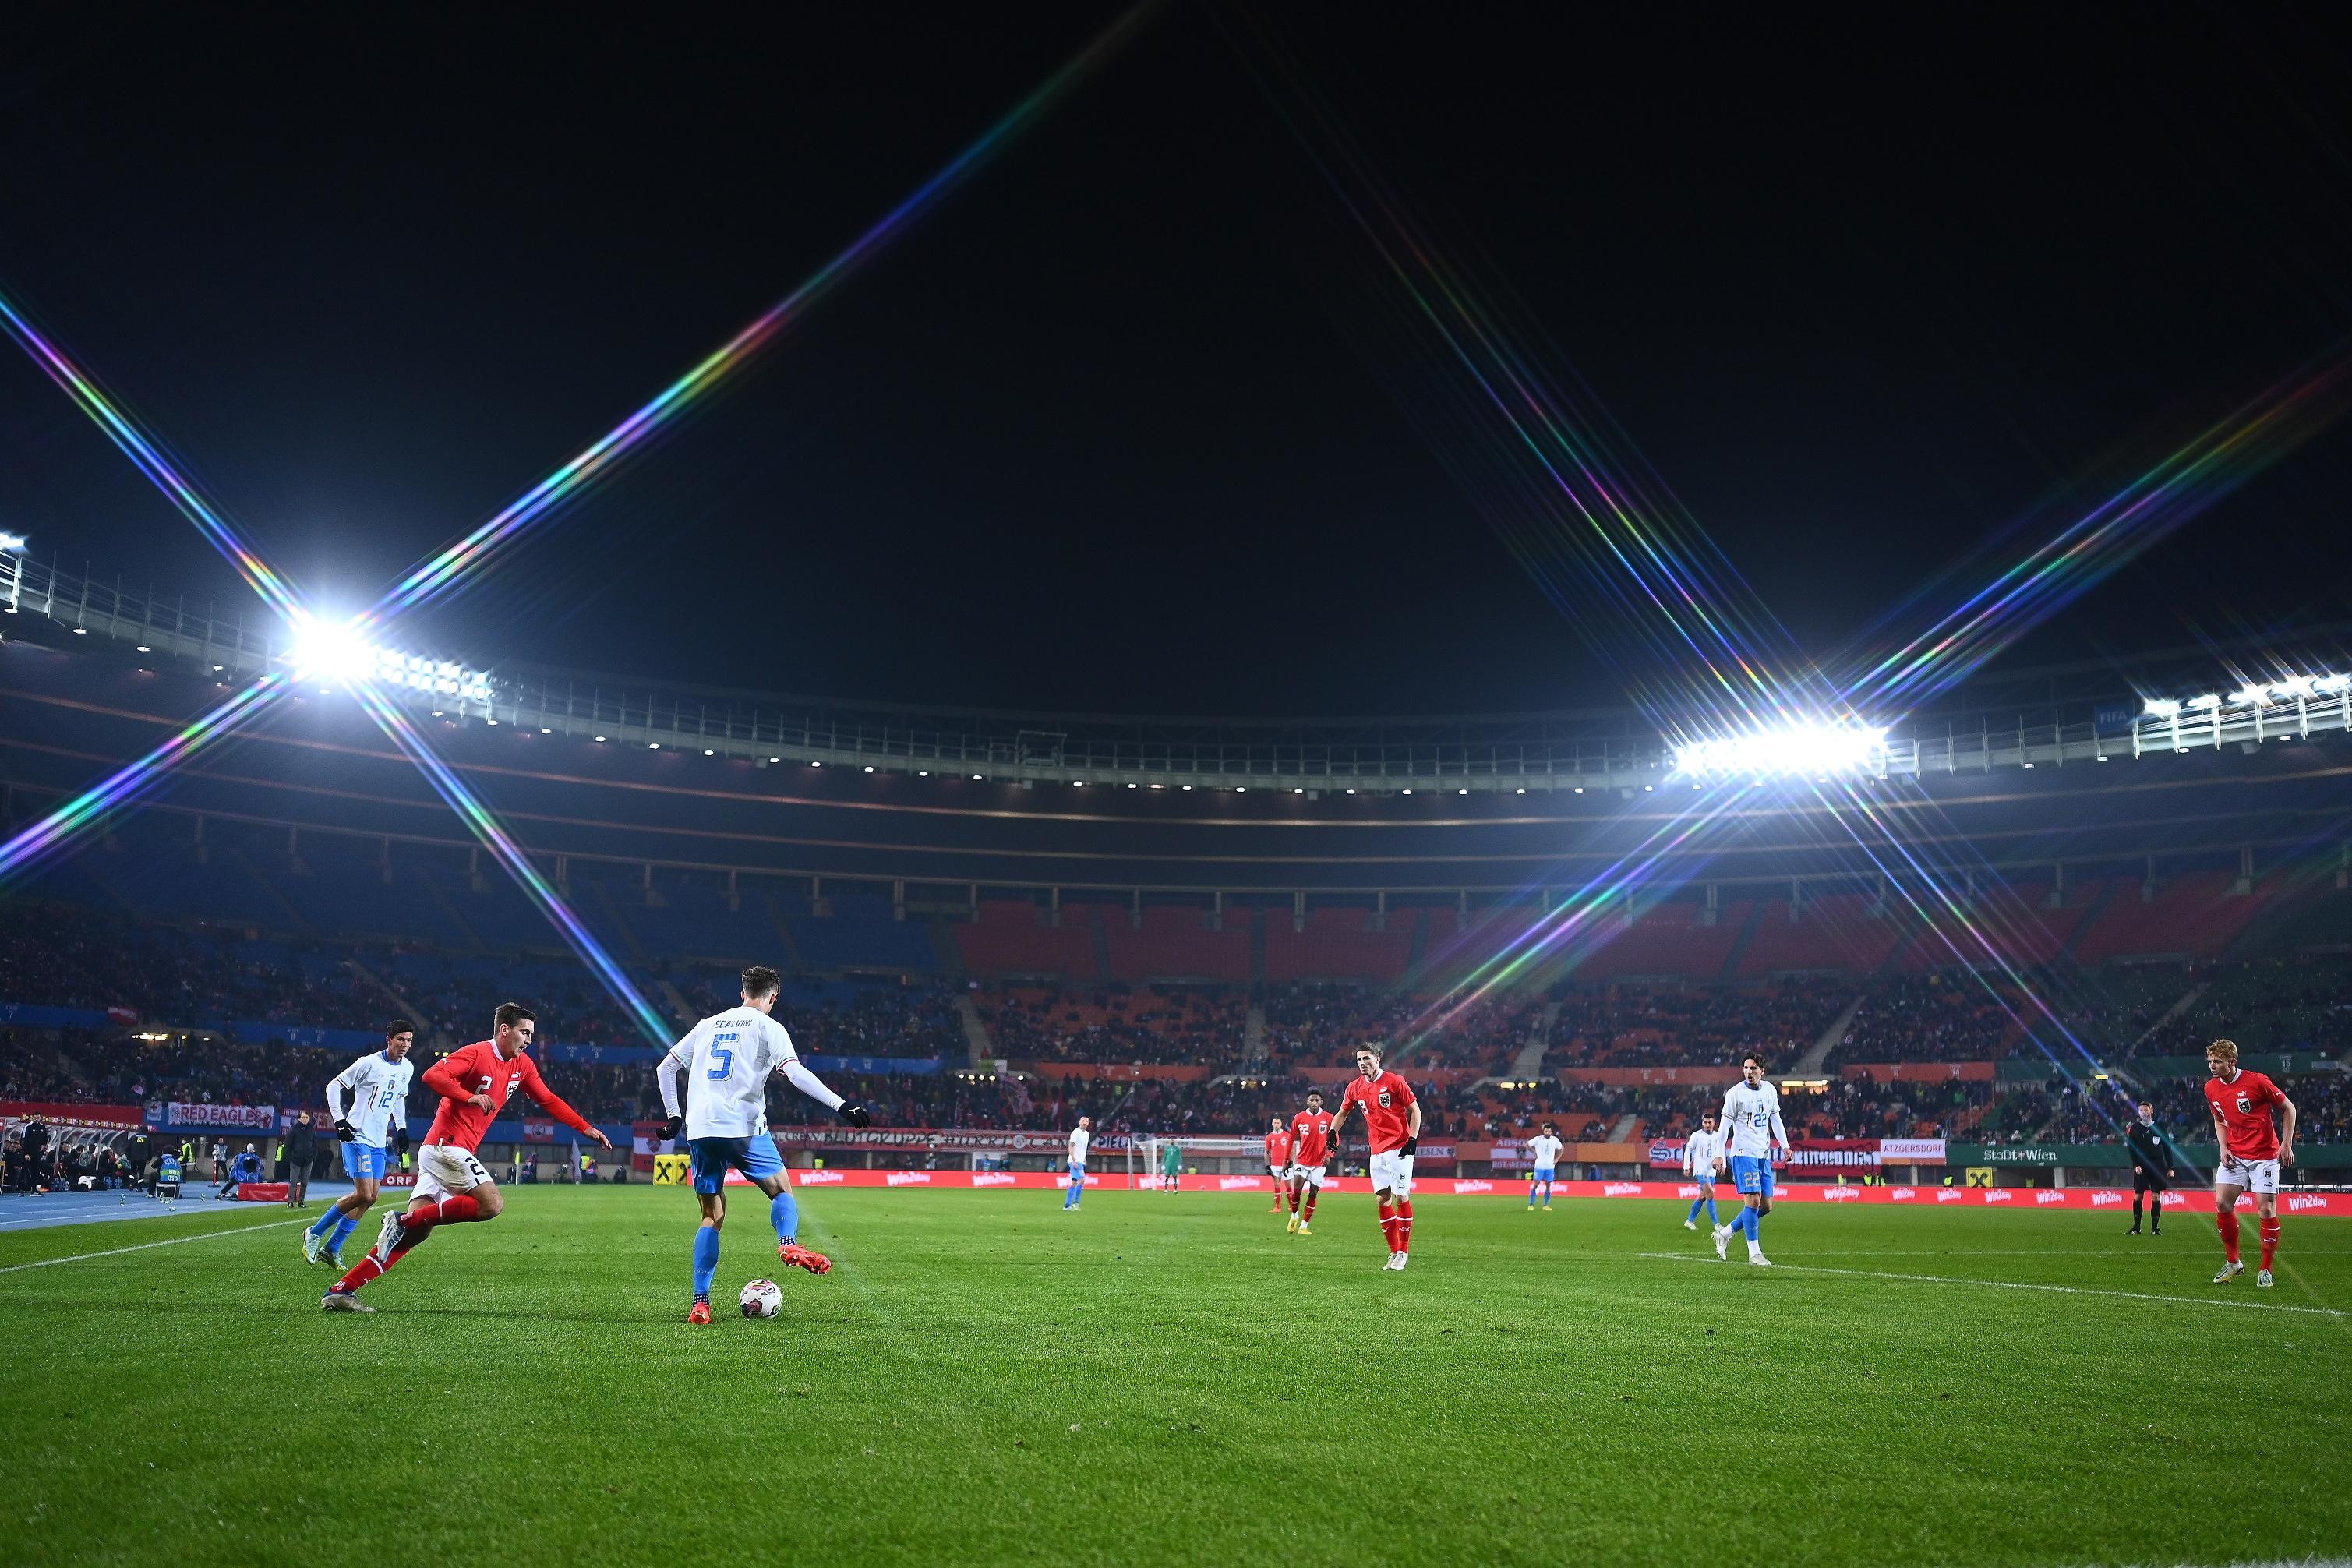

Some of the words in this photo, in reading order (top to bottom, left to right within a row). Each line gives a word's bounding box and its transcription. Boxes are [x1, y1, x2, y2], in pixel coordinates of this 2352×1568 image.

[714, 1019, 753, 1029] SCALVINI
[707, 1033, 740, 1081] 5
[475, 1075, 493, 1095] 2
[378, 1091, 393, 1108] 12
[180, 1107, 207, 1122] RED
[210, 1107, 262, 1124] EAGLES
[1753, 1114, 1767, 1128] 22
[945, 1135, 1008, 1147] HURRI
[1884, 1143, 1943, 1153] ATZGERSDORF
[2026, 1149, 2057, 1161] Wien
[357, 1154, 372, 1173] 12
[465, 1157, 485, 1176] 2
[386, 1176, 413, 1185] ORF
[800, 1171, 844, 1185] win2day
[887, 1171, 930, 1185] win2day
[973, 1171, 1015, 1186] win2day
[1744, 1171, 1760, 1187] 22
[1454, 1179, 1492, 1193] win2day
[1604, 1182, 1642, 1197] win2day
[1824, 1187, 1859, 1200] win2day
[1892, 1187, 1915, 1201] win2day
[1937, 1188, 1962, 1202] win2day
[1985, 1189, 2011, 1203] win2day
[2037, 1189, 2064, 1205] win2day
[2092, 1191, 2122, 1206] win2day
[2160, 1192, 2185, 1206] in2day
[2289, 1194, 2327, 1211] win2day
